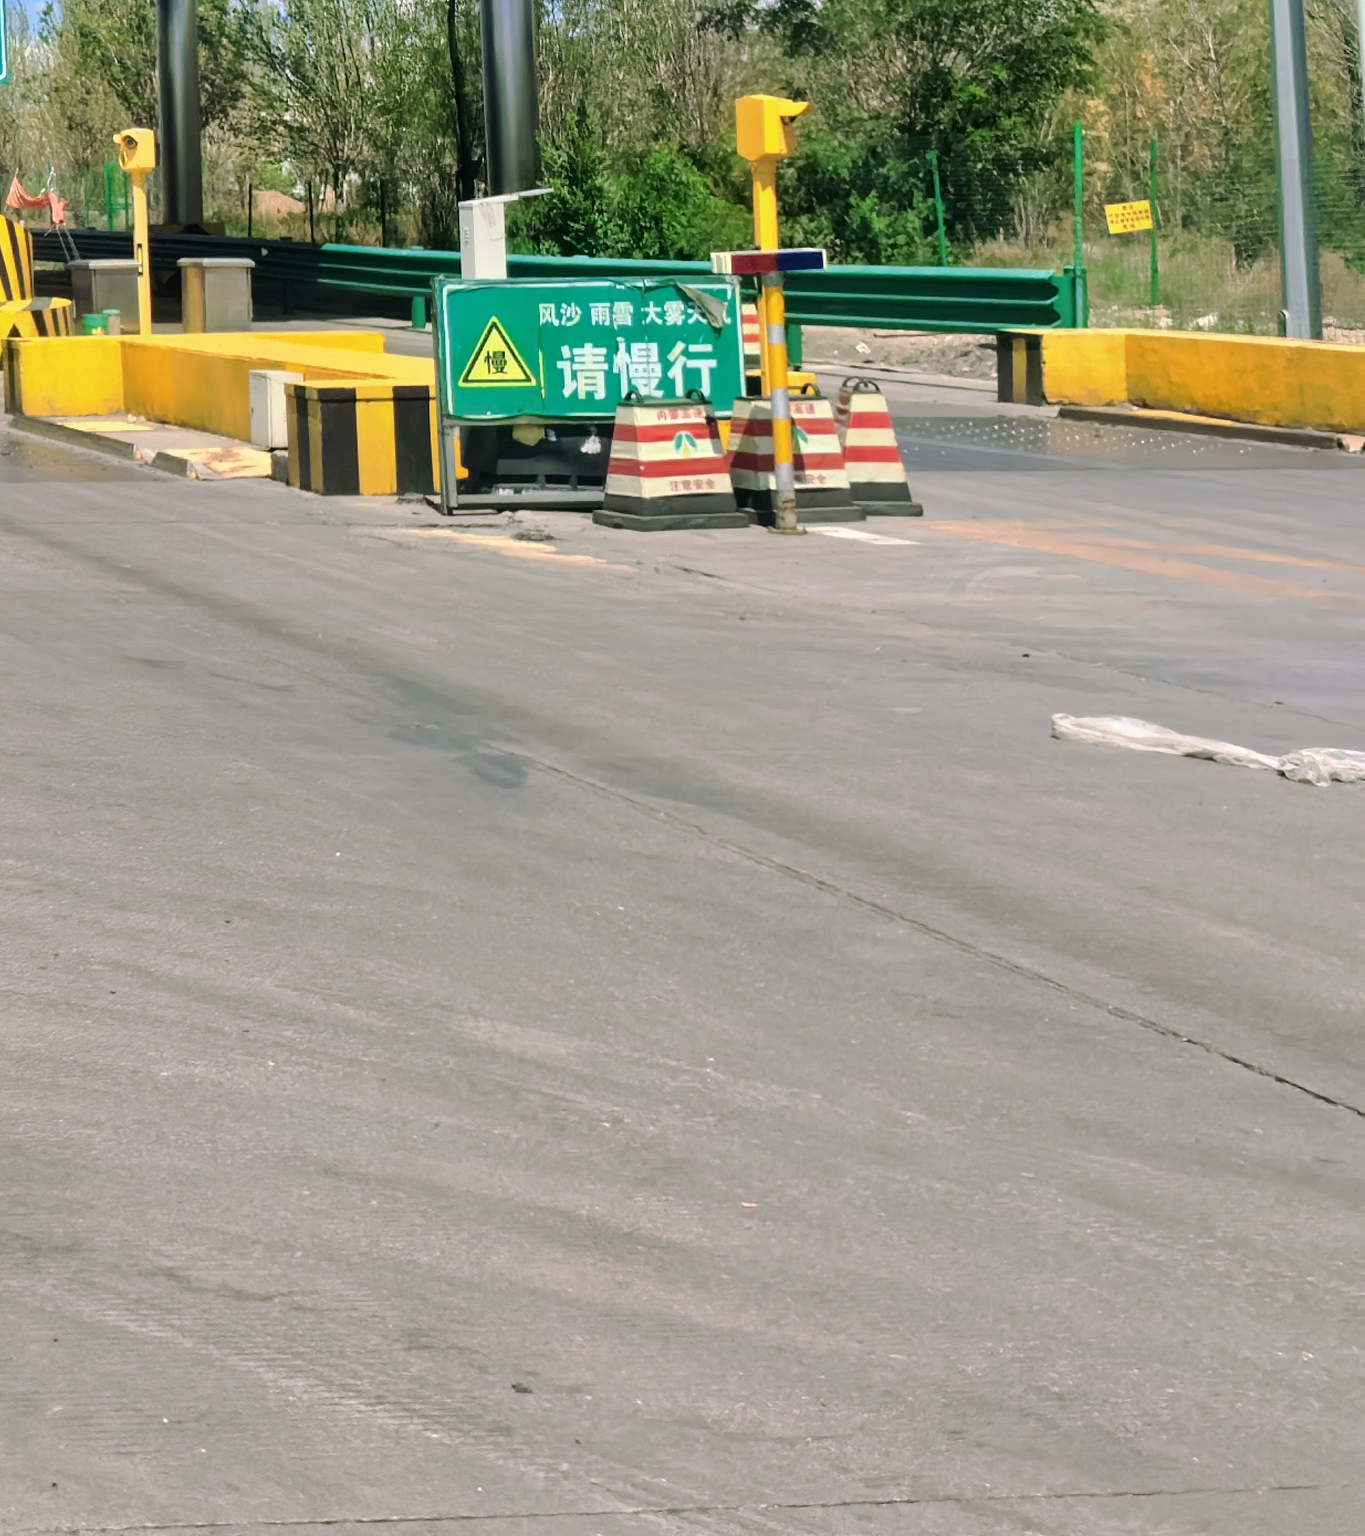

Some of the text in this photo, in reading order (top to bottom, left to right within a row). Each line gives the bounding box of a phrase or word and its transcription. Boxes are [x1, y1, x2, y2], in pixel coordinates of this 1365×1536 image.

[538, 302, 582, 327] 风沙
[641, 300, 732, 327] 大雾天
[483, 350, 509, 376] 慢
[556, 337, 718, 400] 请慢行
